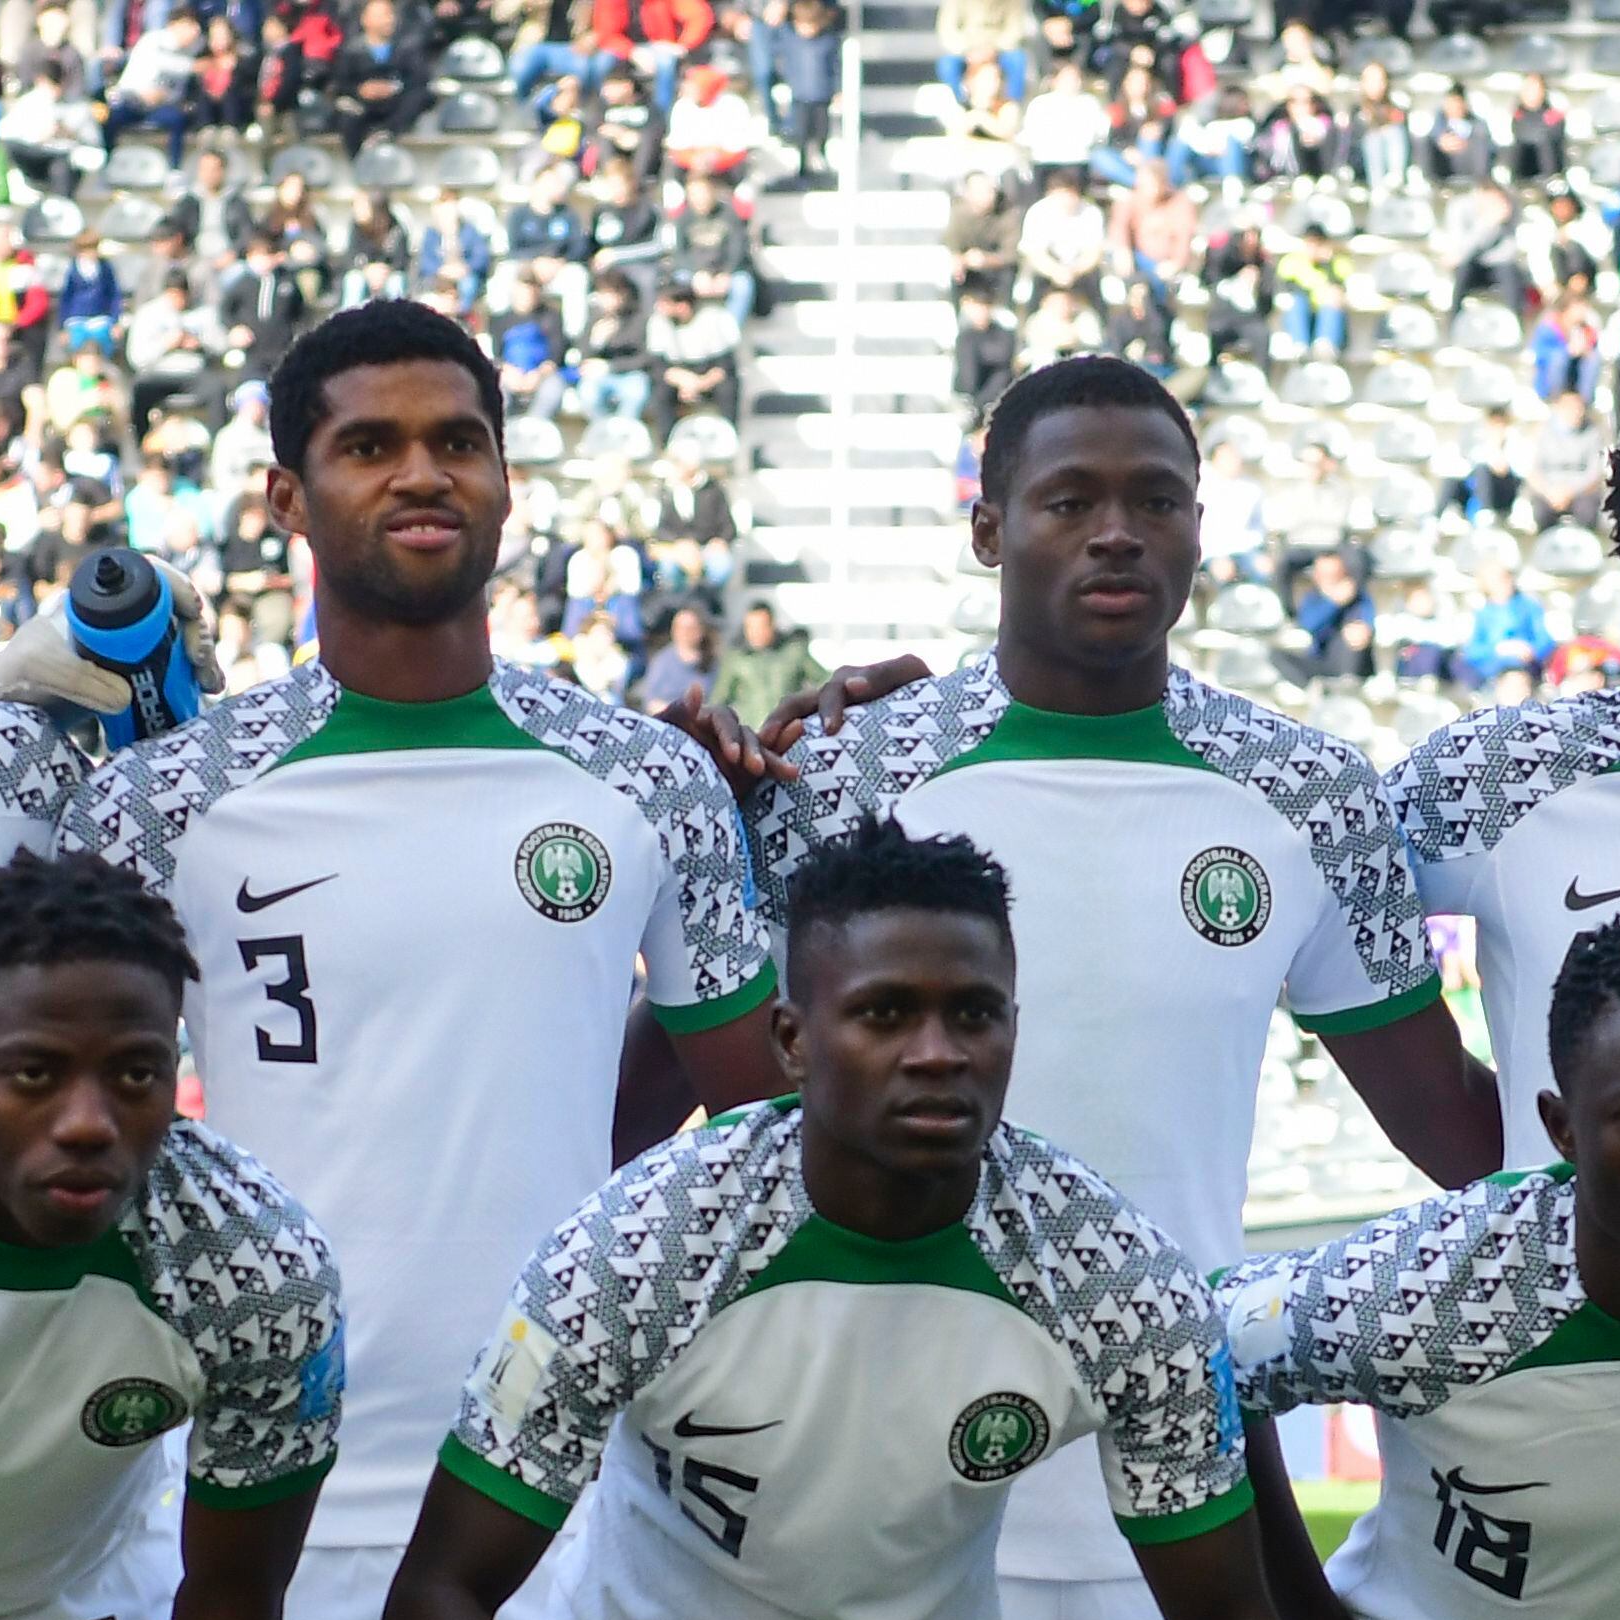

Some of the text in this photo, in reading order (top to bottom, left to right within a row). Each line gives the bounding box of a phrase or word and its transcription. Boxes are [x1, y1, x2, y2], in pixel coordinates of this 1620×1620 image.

[520, 824, 577, 857] FOOTBALL
[1183, 848, 1270, 931] NIGERIA FOOTBALL FEDERATION
[237, 934, 319, 1064] 3
[641, 1432, 759, 1559] 15
[1430, 1466, 1532, 1600] 18
